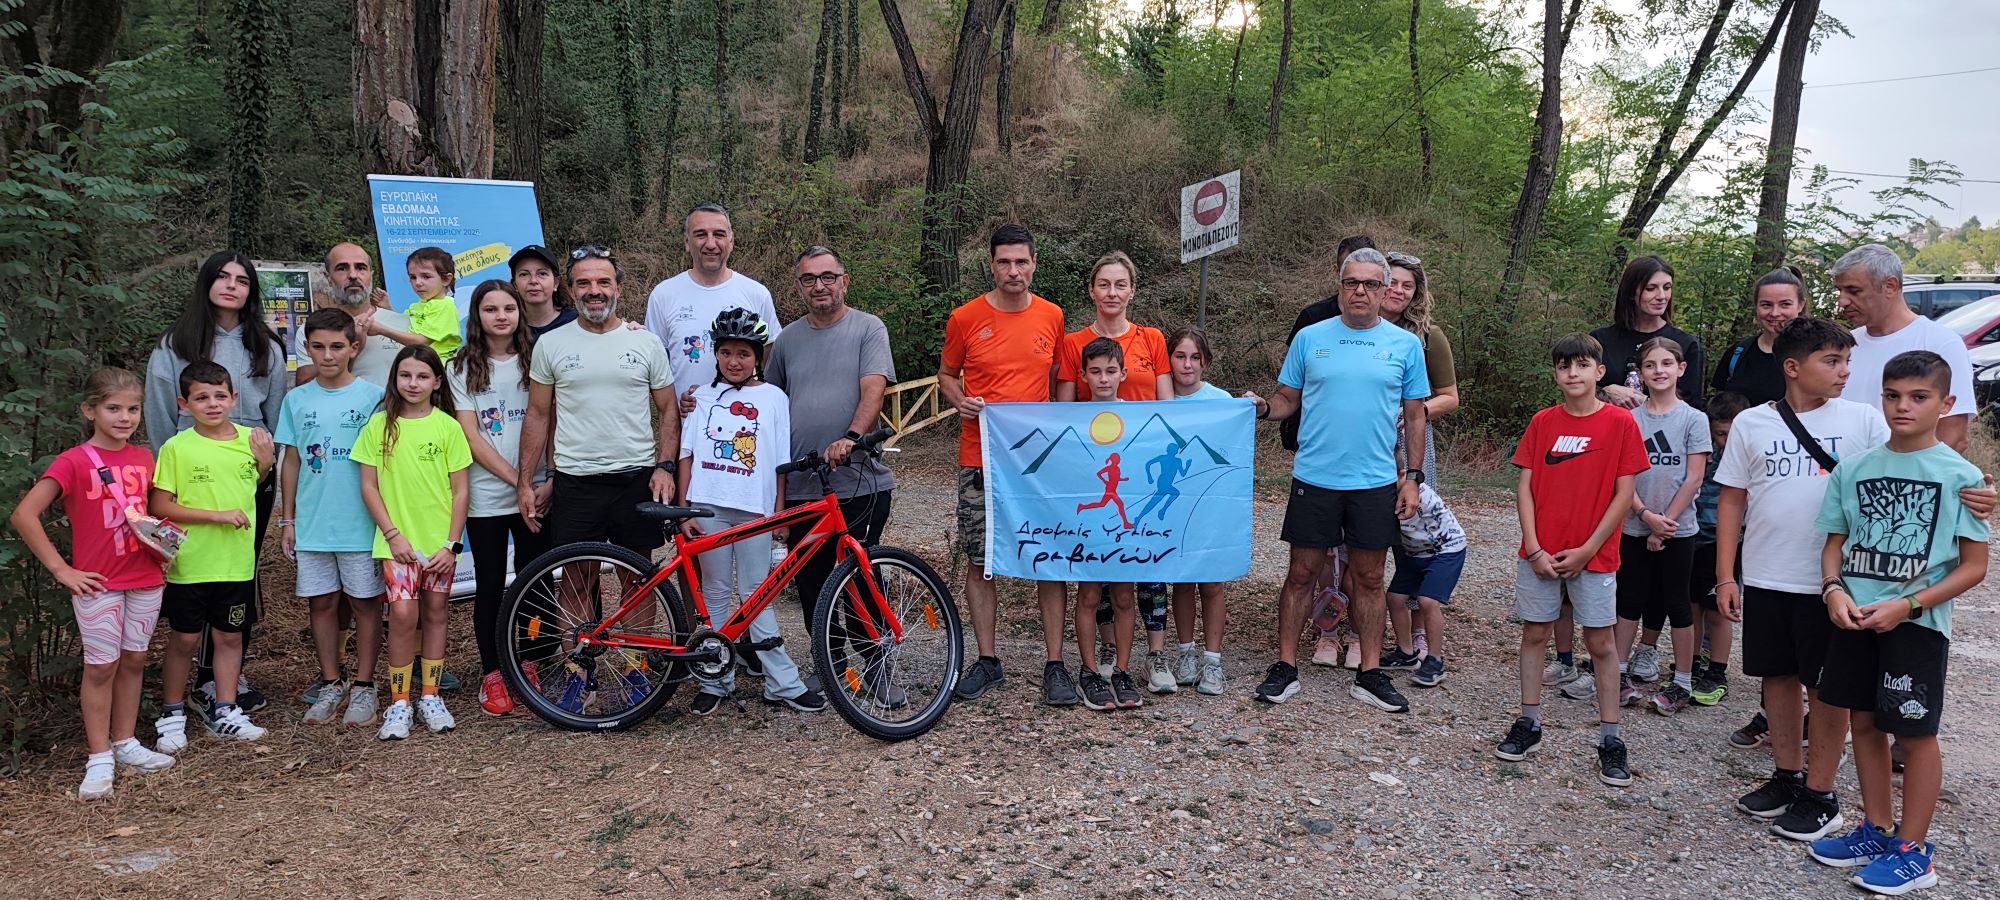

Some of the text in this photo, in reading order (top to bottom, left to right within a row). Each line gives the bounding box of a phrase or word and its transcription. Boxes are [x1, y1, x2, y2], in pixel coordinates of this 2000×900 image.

[380, 191, 438, 203] ΕΥΡΩΠΑΪΚΗ
[381, 203, 441, 215] ΕΒΔΟΜΑΔΑ
[383, 216, 461, 227] ΚΙΝΗΤΙΚΟΤΗΤΑΣ
[386, 228, 407, 236] 16-22
[407, 228, 462, 237] ΣΕΠΤΕΜΒΡΙΟΥ
[455, 249, 484, 265] τικότητα
[456, 252, 501, 279] για όλους
[1339, 339, 1376, 347] GIVOVA
[1551, 435, 1592, 454] NIKE
[1765, 436, 1843, 456] JUT
[1648, 452, 1681, 466] das
[1765, 457, 1791, 477] DO
[701, 461, 755, 477] HELLO KITTY
[1015, 520, 1092, 542] Δρομείς
[1017, 540, 1177, 574] Γρεβενών
[1887, 555, 1929, 580] DAY
